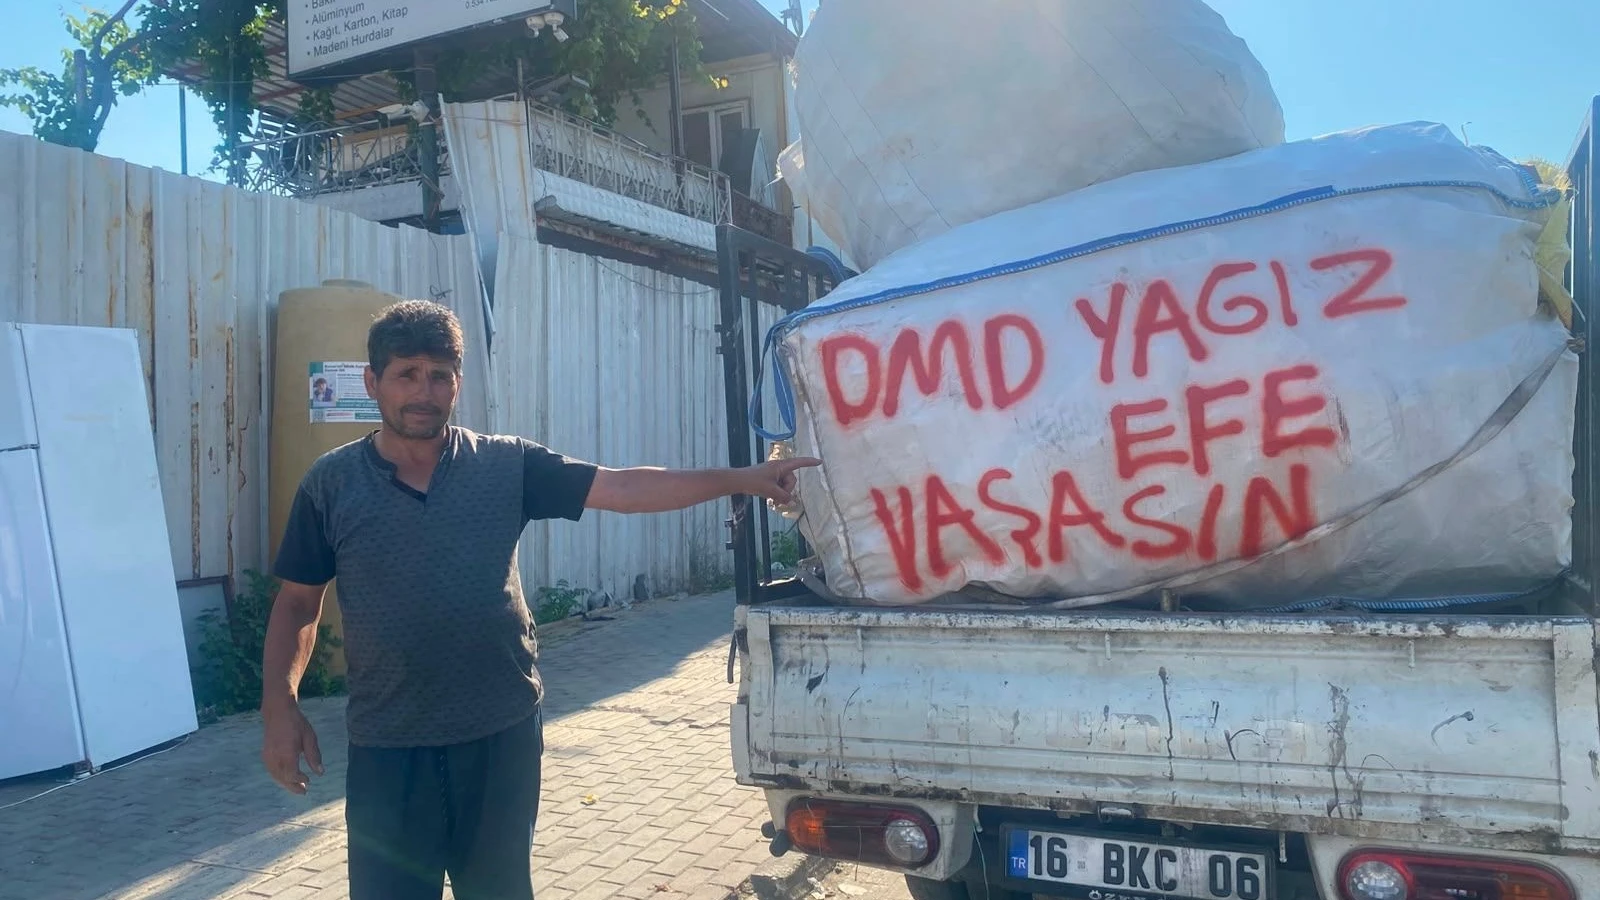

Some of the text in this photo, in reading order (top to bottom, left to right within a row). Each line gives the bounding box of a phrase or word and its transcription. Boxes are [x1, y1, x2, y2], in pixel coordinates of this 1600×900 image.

[311, 2, 365, 25] Alüminyum
[343, 15, 379, 32] Karton,
[382, 6, 408, 21] Kitap
[313, 26, 394, 57] Madeni Hurdalar
[1110, 364, 1337, 479] EFE
[1011, 857, 1026, 869] TR
[1030, 835, 1259, 900] 16 BKC 06
